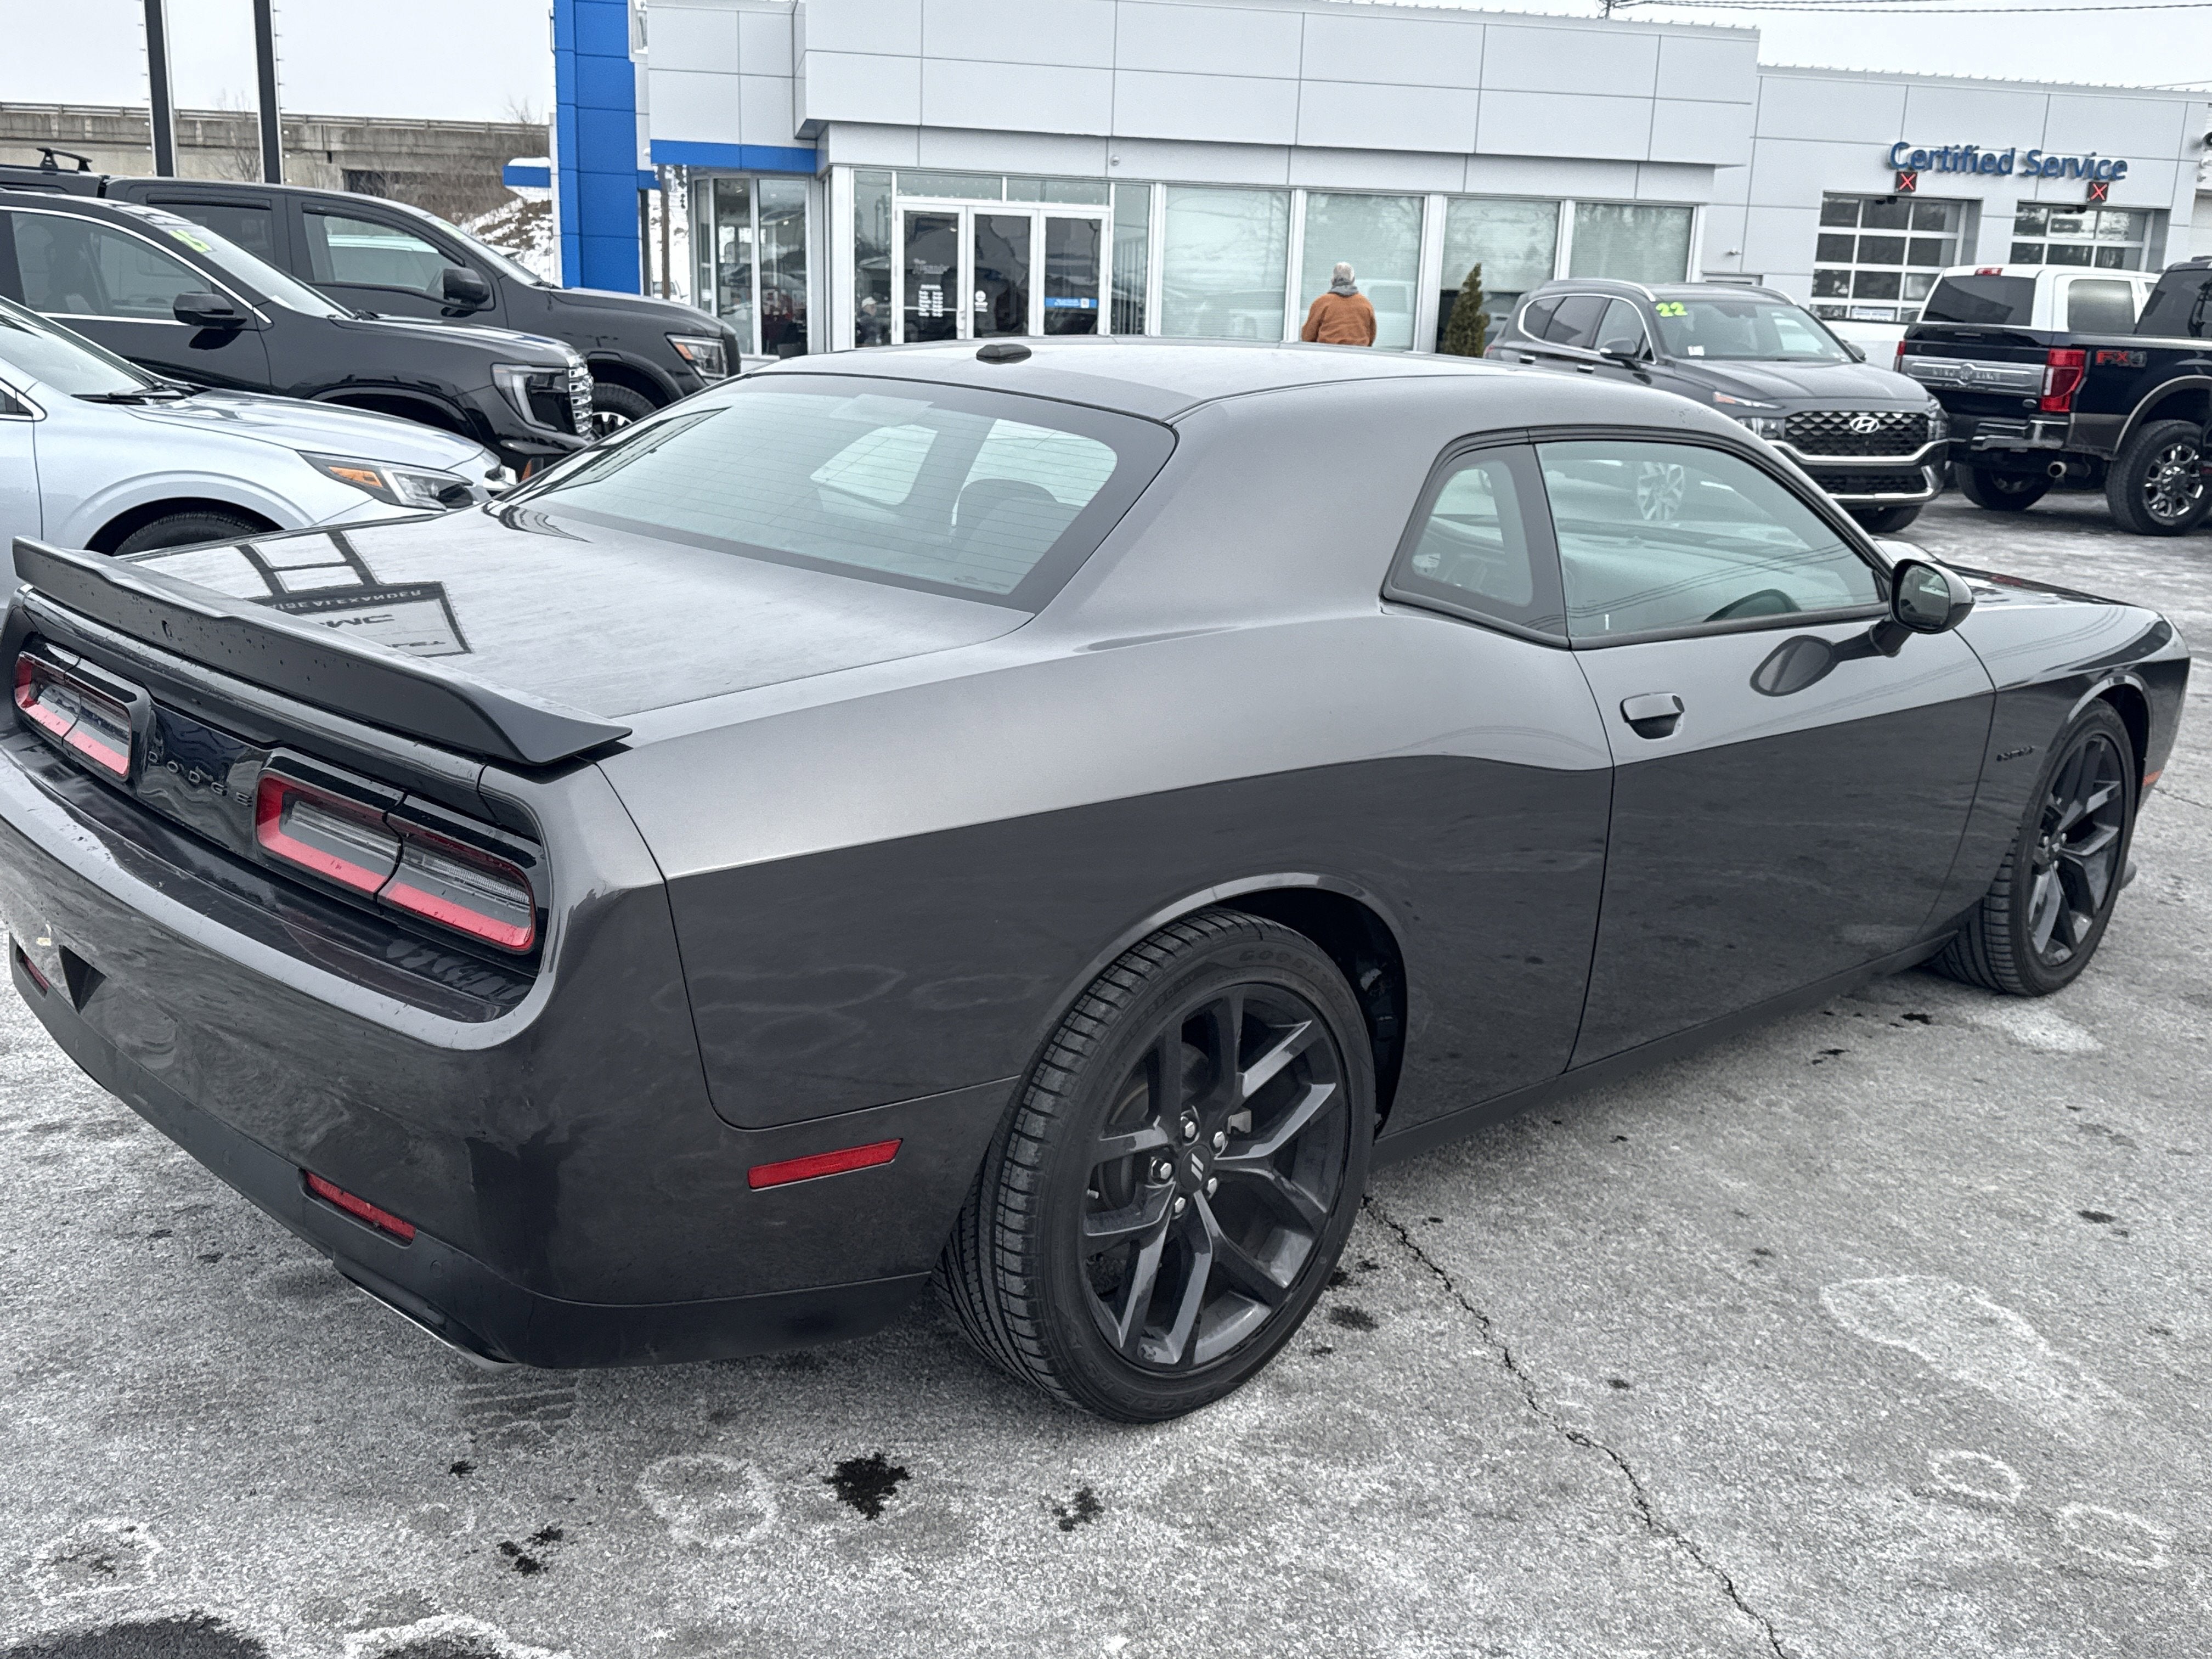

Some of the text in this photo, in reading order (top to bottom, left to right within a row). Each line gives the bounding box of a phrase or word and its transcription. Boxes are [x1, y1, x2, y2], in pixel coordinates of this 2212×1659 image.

[1889, 141, 2128, 180] Certified Service
[1656, 302, 1688, 317] 22
[148, 750, 253, 806] DODGE
